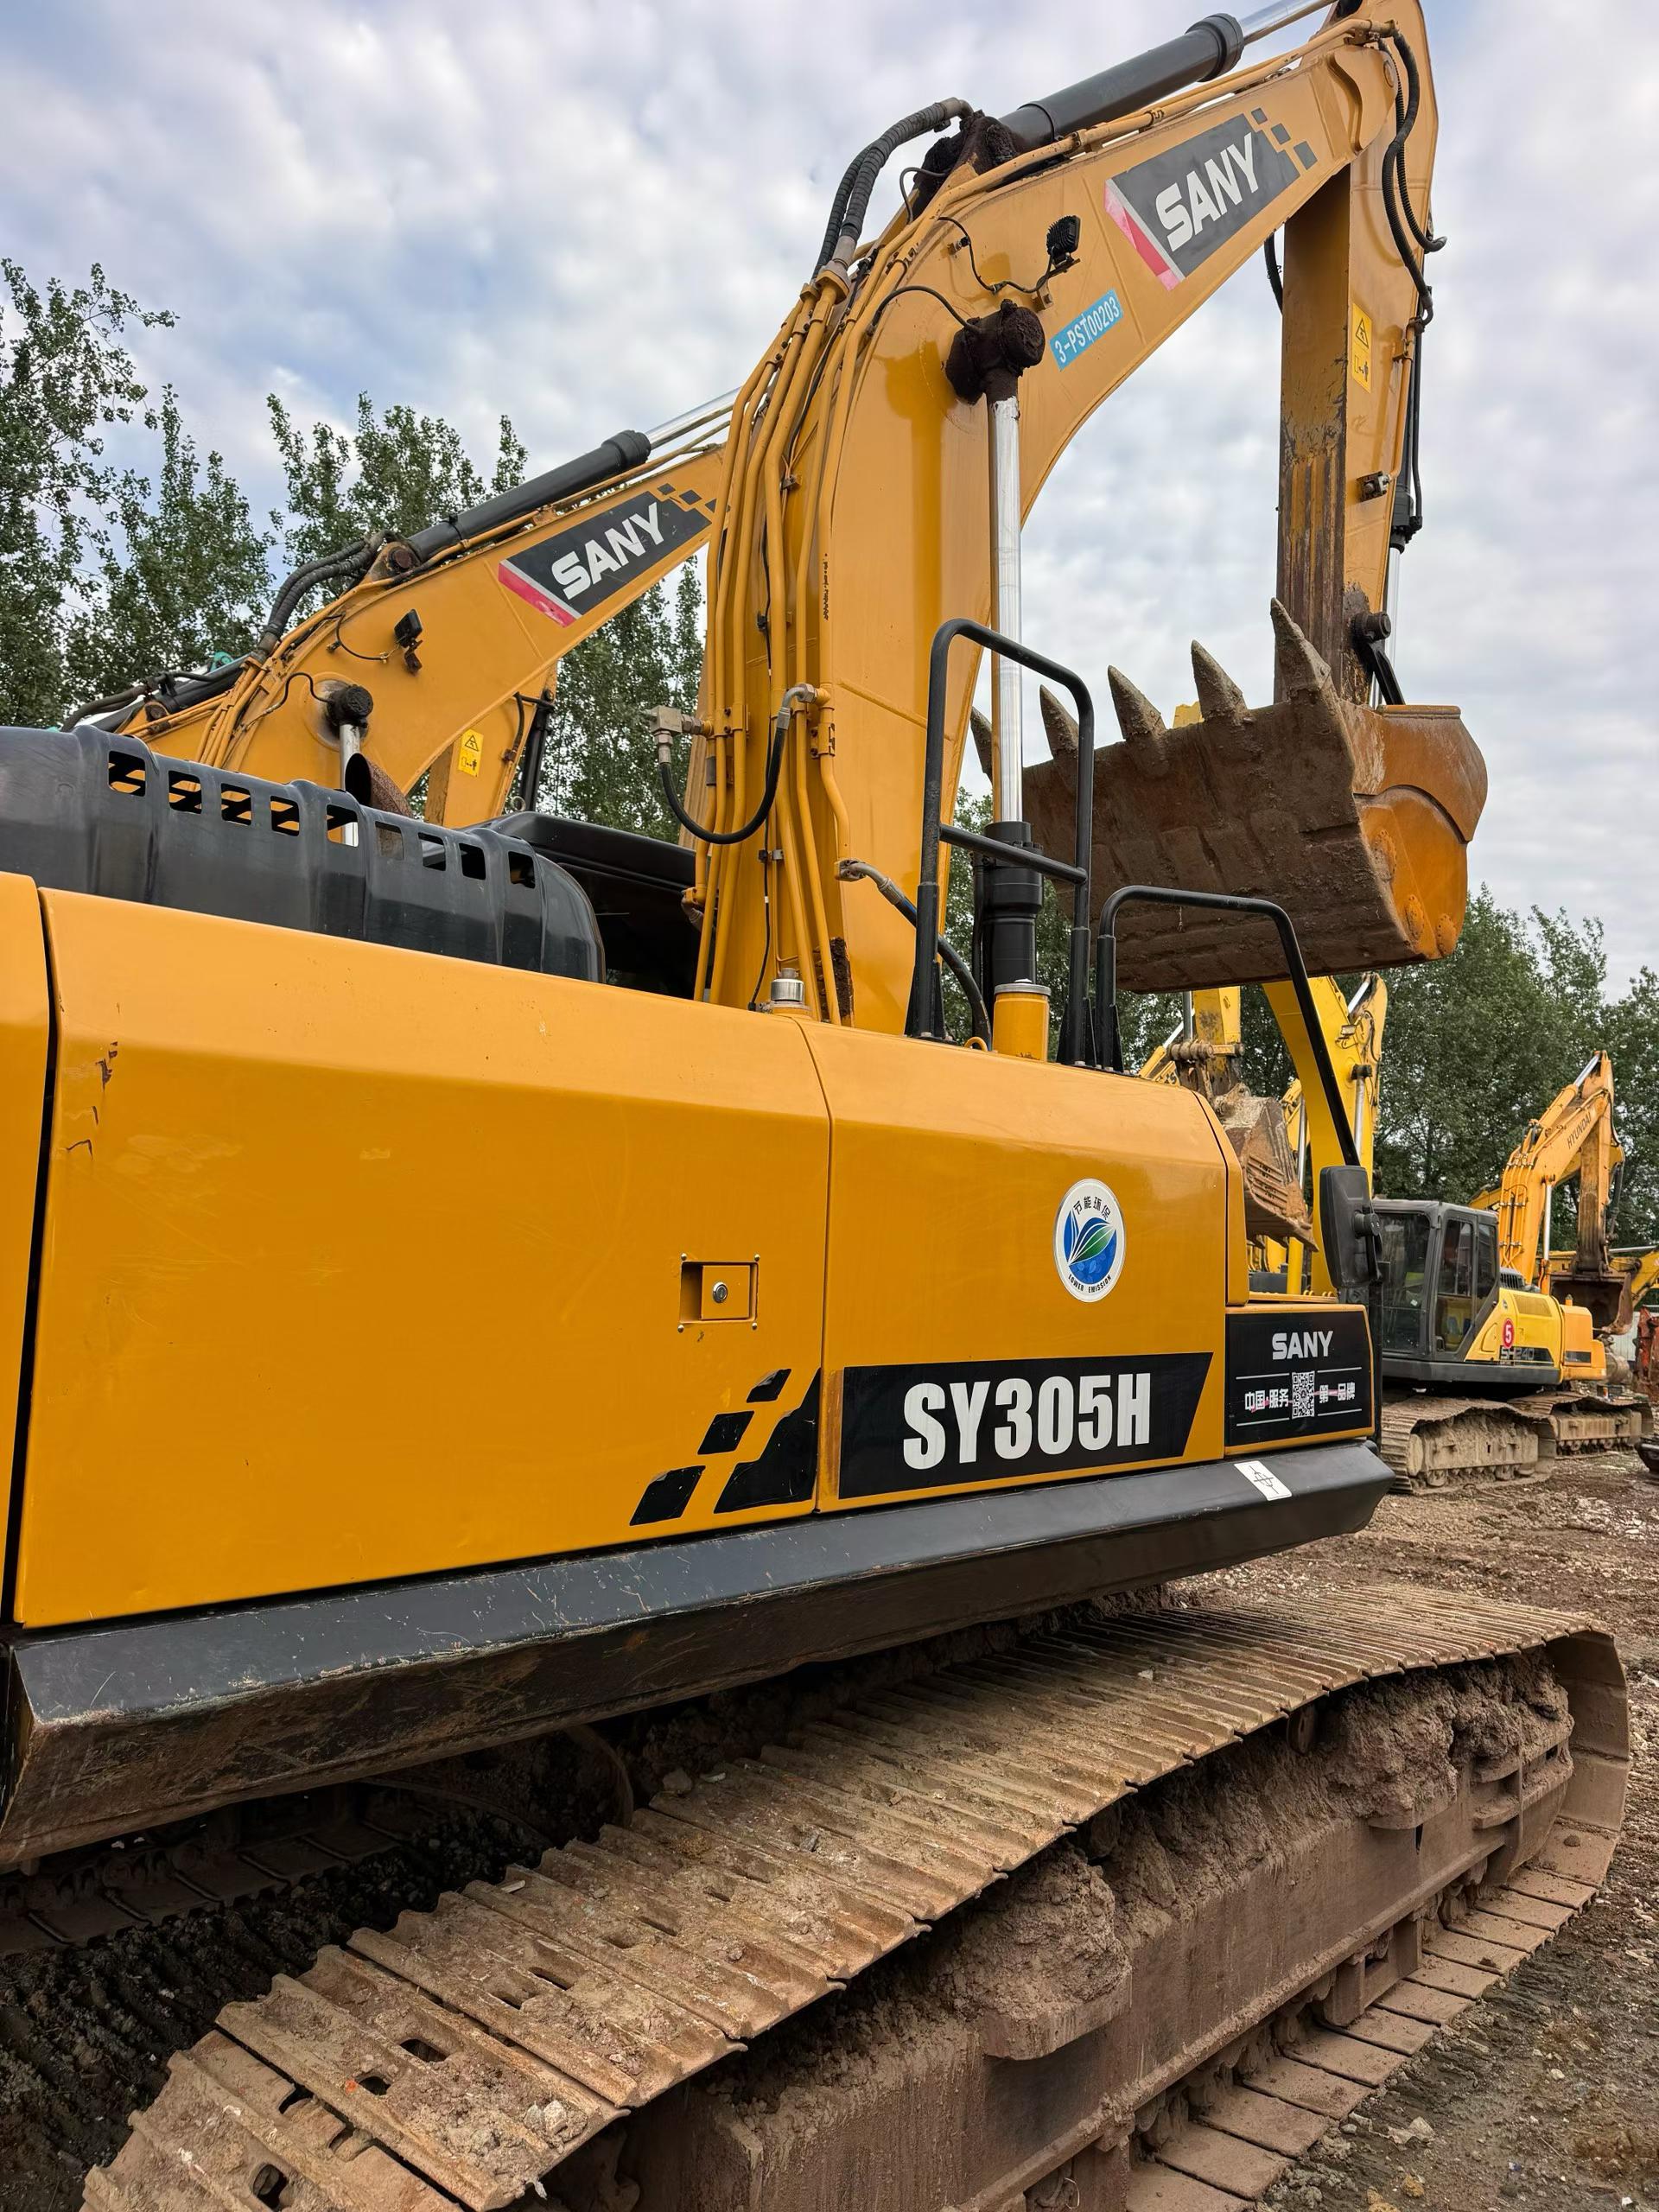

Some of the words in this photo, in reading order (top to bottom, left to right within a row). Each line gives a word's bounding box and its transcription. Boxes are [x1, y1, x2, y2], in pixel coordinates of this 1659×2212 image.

[1155, 132, 1259, 251] SANY
[1054, 296, 1120, 363] 3-PST00203
[551, 501, 664, 601] SANY
[1068, 1274, 1084, 1292] LOWER
[1088, 1274, 1112, 1294] EMISSION
[1272, 1331, 1333, 1360] SANY
[1504, 1324, 1513, 1344] 5
[902, 1372, 1151, 1470] SY305H
